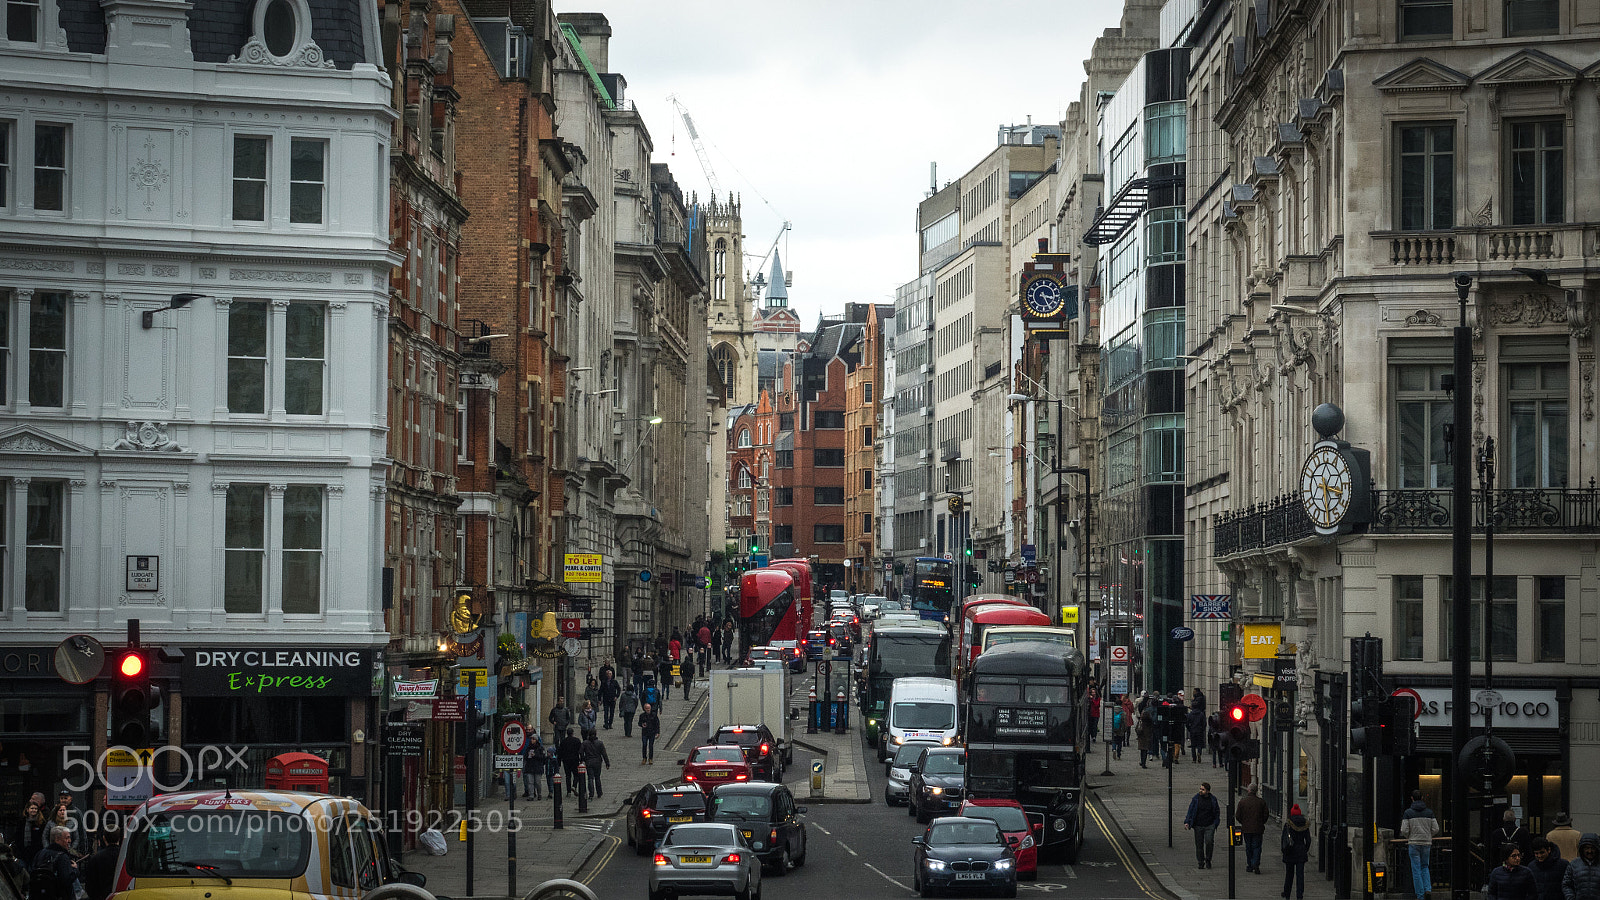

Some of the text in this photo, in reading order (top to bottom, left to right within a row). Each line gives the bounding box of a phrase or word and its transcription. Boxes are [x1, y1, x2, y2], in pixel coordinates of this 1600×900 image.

[766, 608, 775, 616] 76
[1250, 635, 1275, 645] EAT.
[195, 651, 243, 667] DRY
[243, 651, 361, 667] CLEANING
[227, 671, 332, 693] Express
[398, 684, 415, 692] Krispy
[1498, 701, 1519, 716] TO
[1522, 701, 1550, 717] GO
